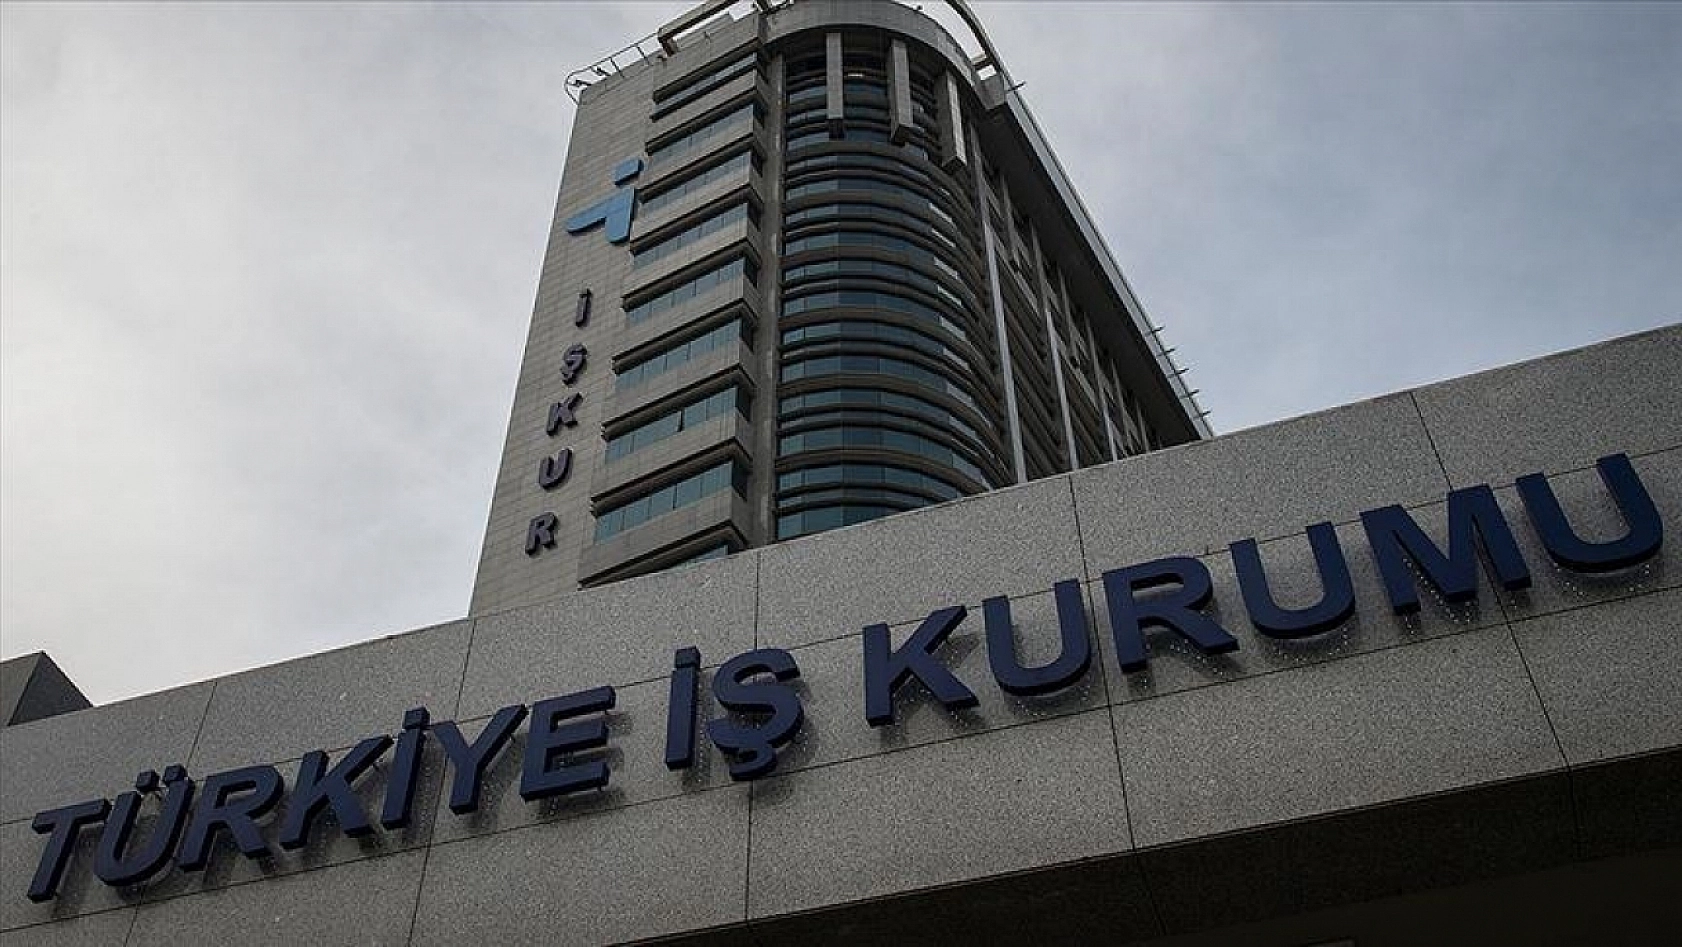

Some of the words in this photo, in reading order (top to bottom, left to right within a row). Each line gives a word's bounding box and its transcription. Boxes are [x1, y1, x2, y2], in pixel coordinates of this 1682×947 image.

[525, 288, 592, 555] İŞKUR
[27, 685, 617, 902] TÜRKİYE
[665, 646, 804, 781] İŞ
[863, 453, 1664, 727] KURUMU
